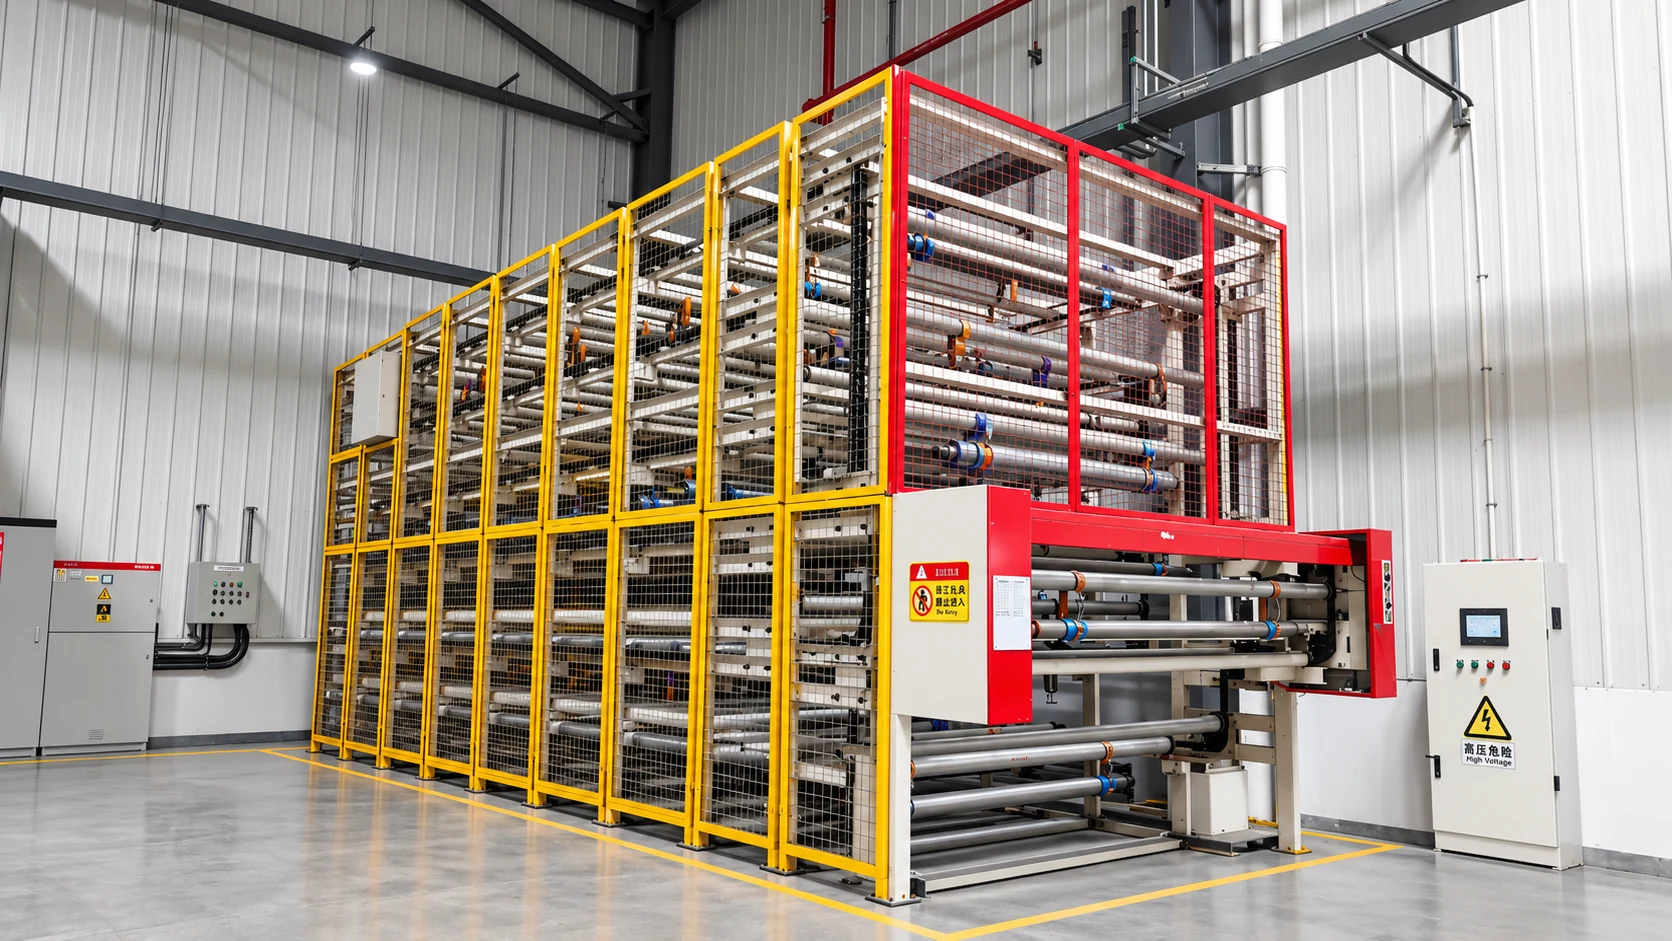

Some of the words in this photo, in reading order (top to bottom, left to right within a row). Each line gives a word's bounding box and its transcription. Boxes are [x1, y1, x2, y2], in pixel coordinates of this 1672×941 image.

[1464, 743, 1512, 758] 高压危险
[1466, 755, 1483, 764] High
